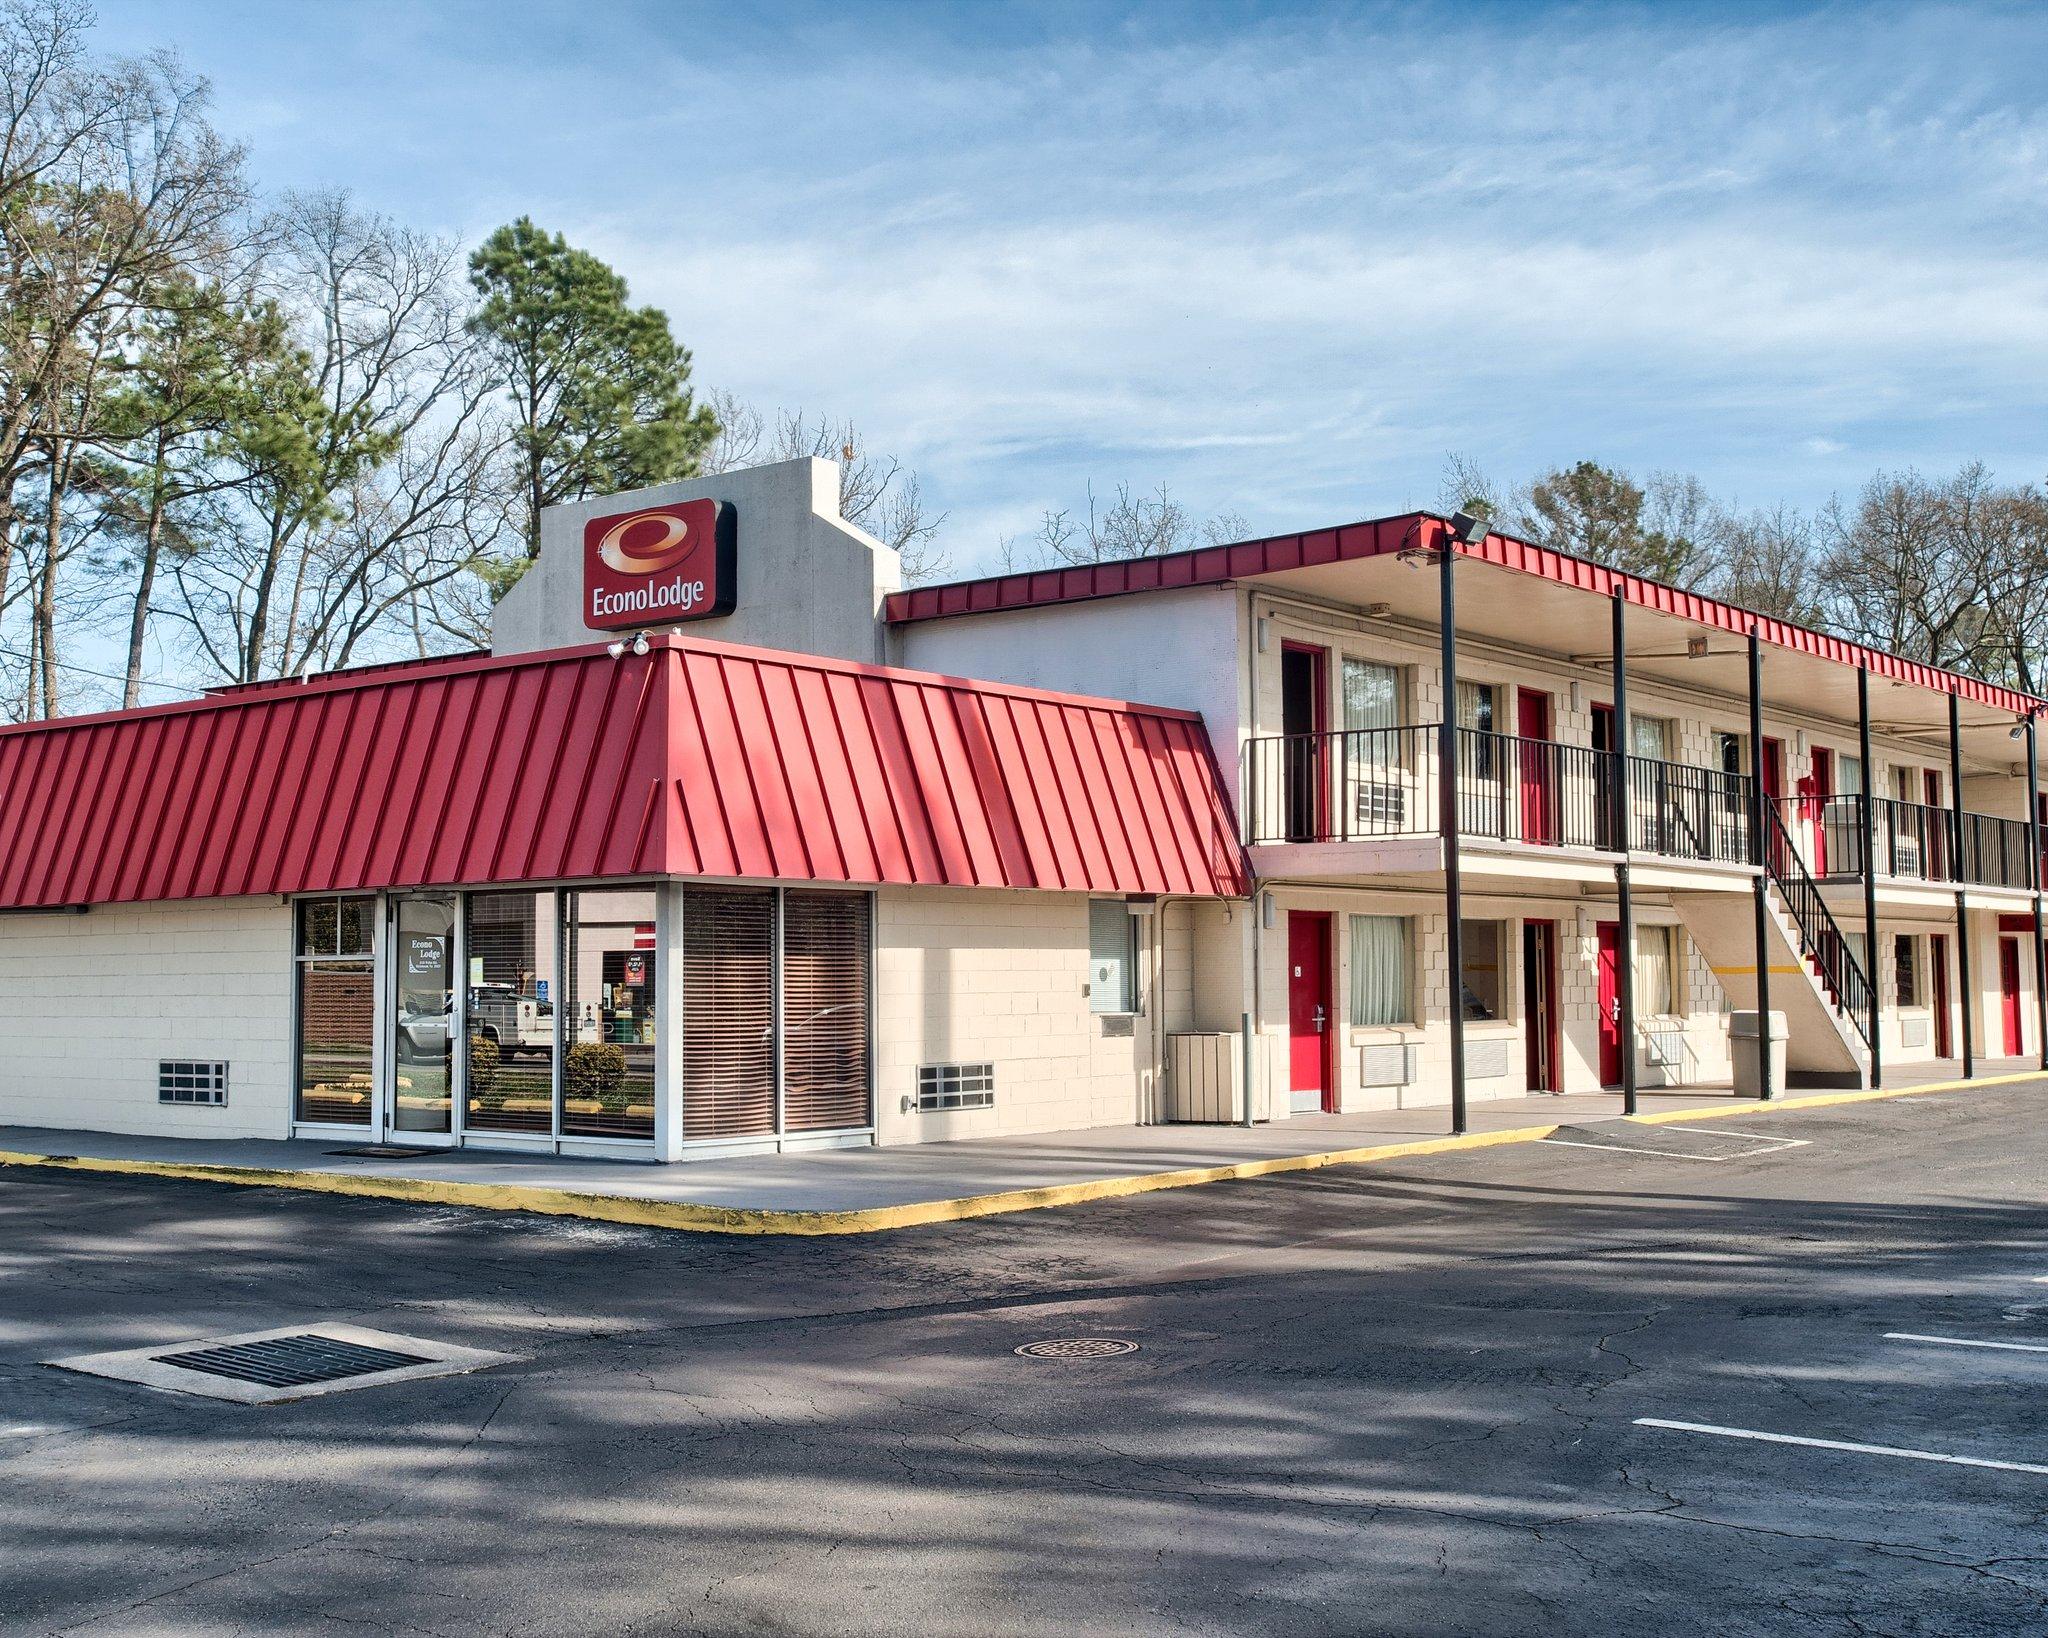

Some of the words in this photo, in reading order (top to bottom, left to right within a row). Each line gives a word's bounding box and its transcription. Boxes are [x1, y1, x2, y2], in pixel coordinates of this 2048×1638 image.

[593, 576, 704, 616] EconoLodge
[412, 940, 433, 949] Econo
[420, 950, 441, 960] Lodge
